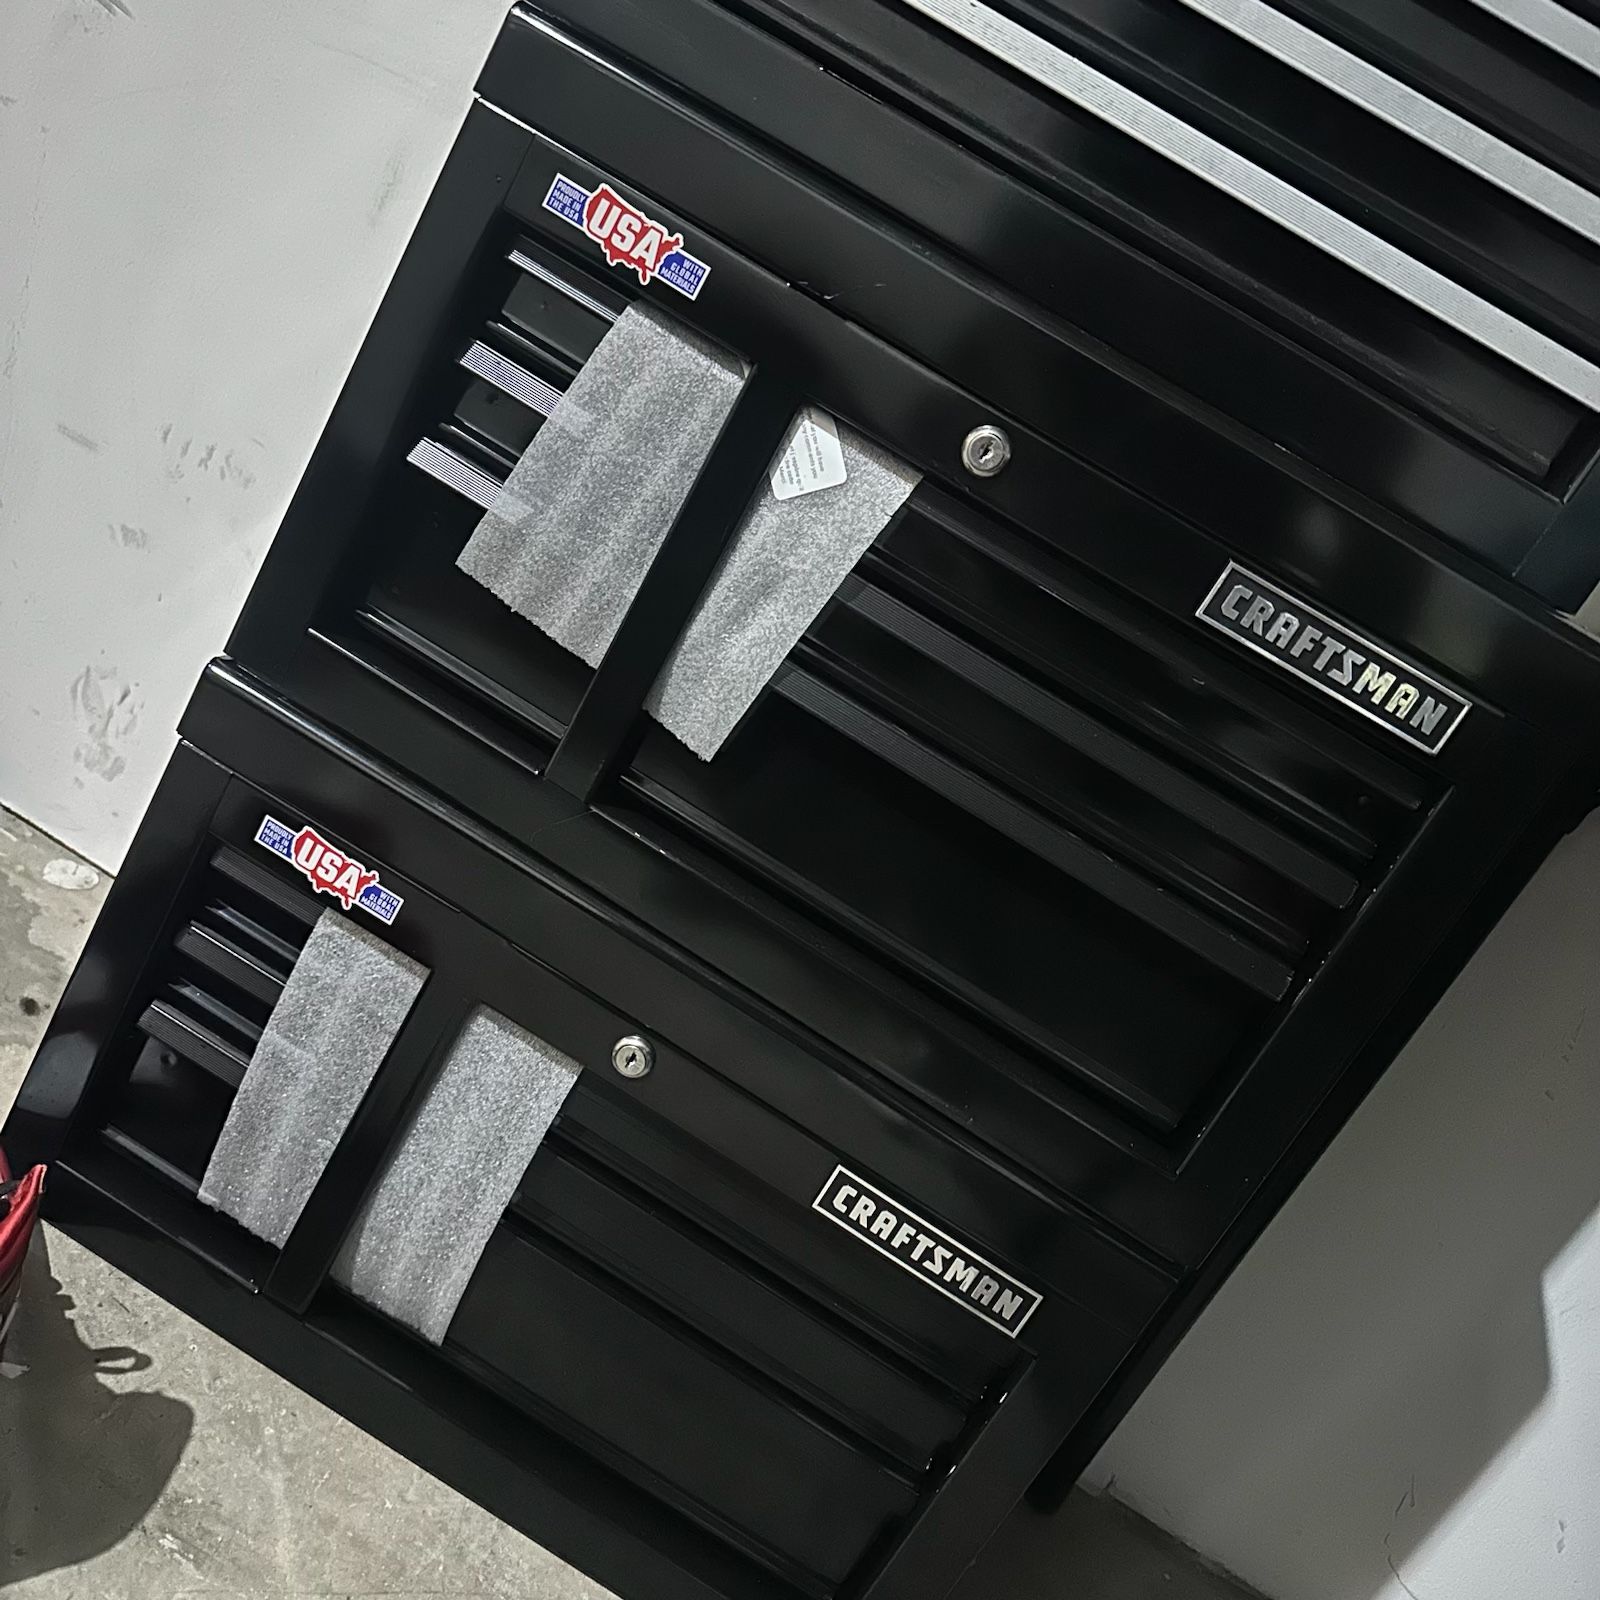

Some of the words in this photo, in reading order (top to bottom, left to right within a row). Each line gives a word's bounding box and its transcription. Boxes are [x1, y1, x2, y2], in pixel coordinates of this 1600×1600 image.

[552, 189, 572, 208] MADE
[571, 200, 582, 212] IN
[556, 181, 586, 203] PROUDLY
[548, 197, 565, 212] THE
[563, 206, 580, 221] USA
[589, 197, 662, 270] USA
[670, 262, 701, 286] GLOBAL
[682, 259, 705, 277] WITH
[660, 267, 696, 293] MATERIALS
[1220, 584, 1448, 736] CRAFTSMAN
[263, 828, 282, 843] MADE
[281, 838, 290, 847] IN
[266, 821, 293, 840] PROUDLY
[260, 834, 273, 846] THE
[274, 843, 288, 855] USA
[296, 837, 361, 899] USA
[360, 896, 392, 920] MATERIALS
[369, 893, 395, 913] GLOBAL
[379, 891, 399, 907] WITH
[832, 1184, 1023, 1321] CRAFTSMAN
